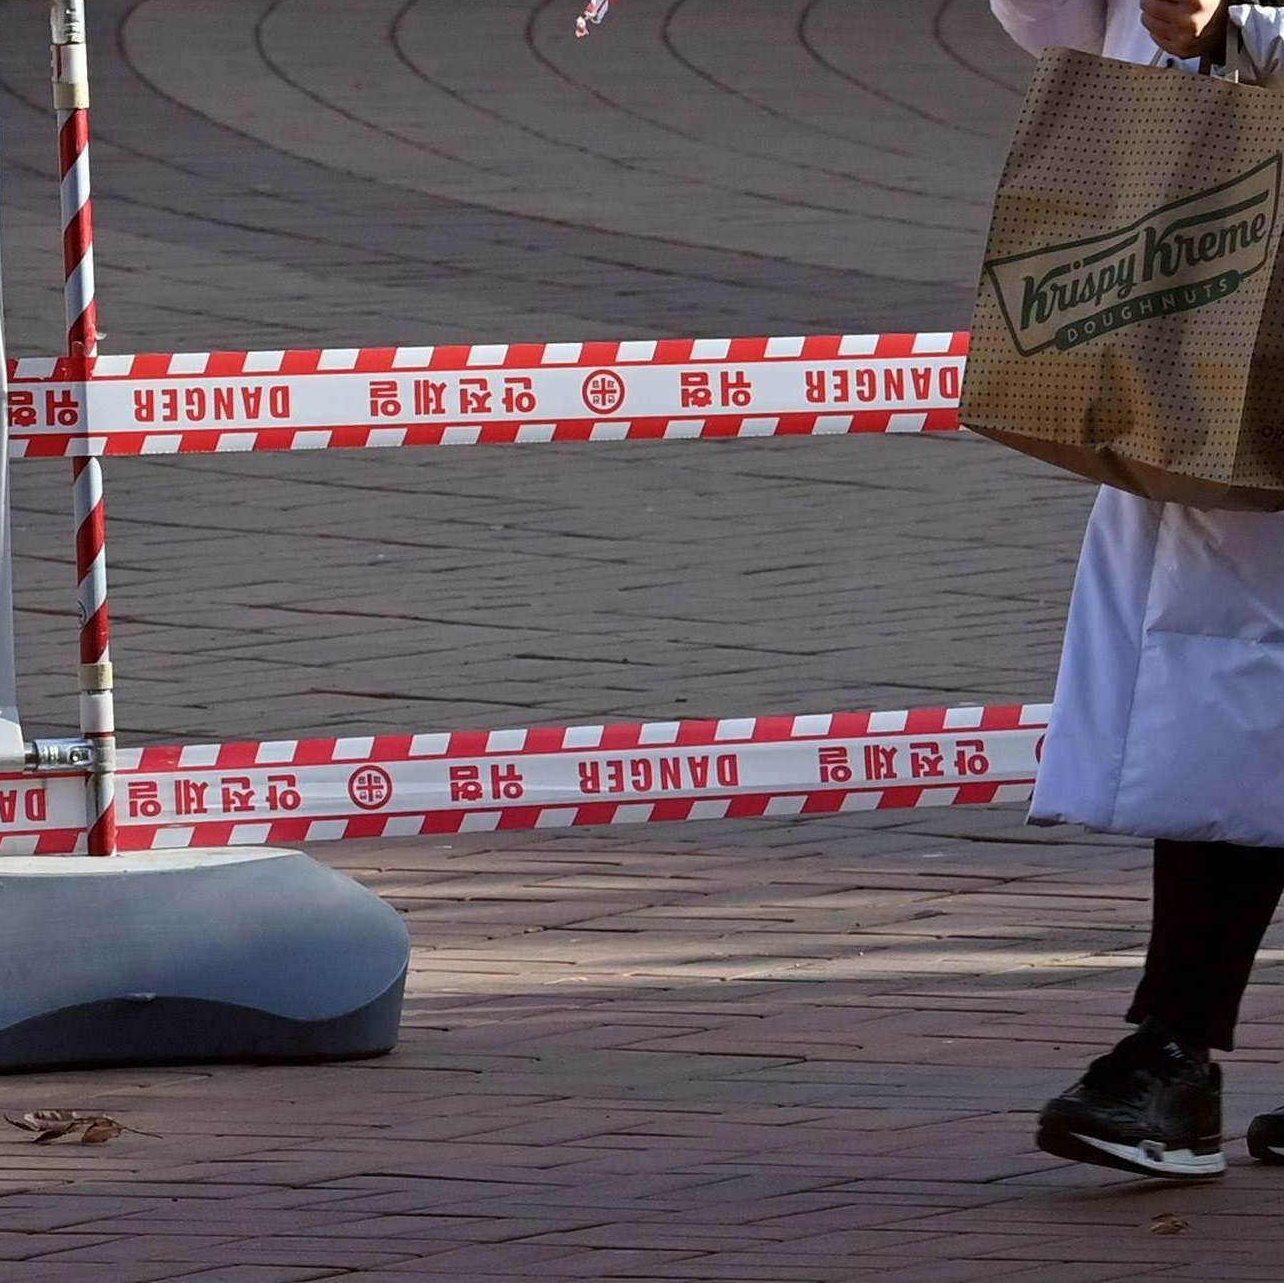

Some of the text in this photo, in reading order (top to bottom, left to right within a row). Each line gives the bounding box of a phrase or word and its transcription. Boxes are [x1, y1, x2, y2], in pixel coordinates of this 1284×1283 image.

[1020, 189, 1270, 332] Krispy Kreme
[1066, 278, 1230, 344] DOUGHNUTS
[8, 366, 960, 427] DANGER 위험 안전제일 DANGER 위험
[449, 764, 524, 803] 위험
[579, 753, 738, 794] DANGER
[818, 738, 989, 784] 안전제일
[128, 774, 302, 818] 안전제일
